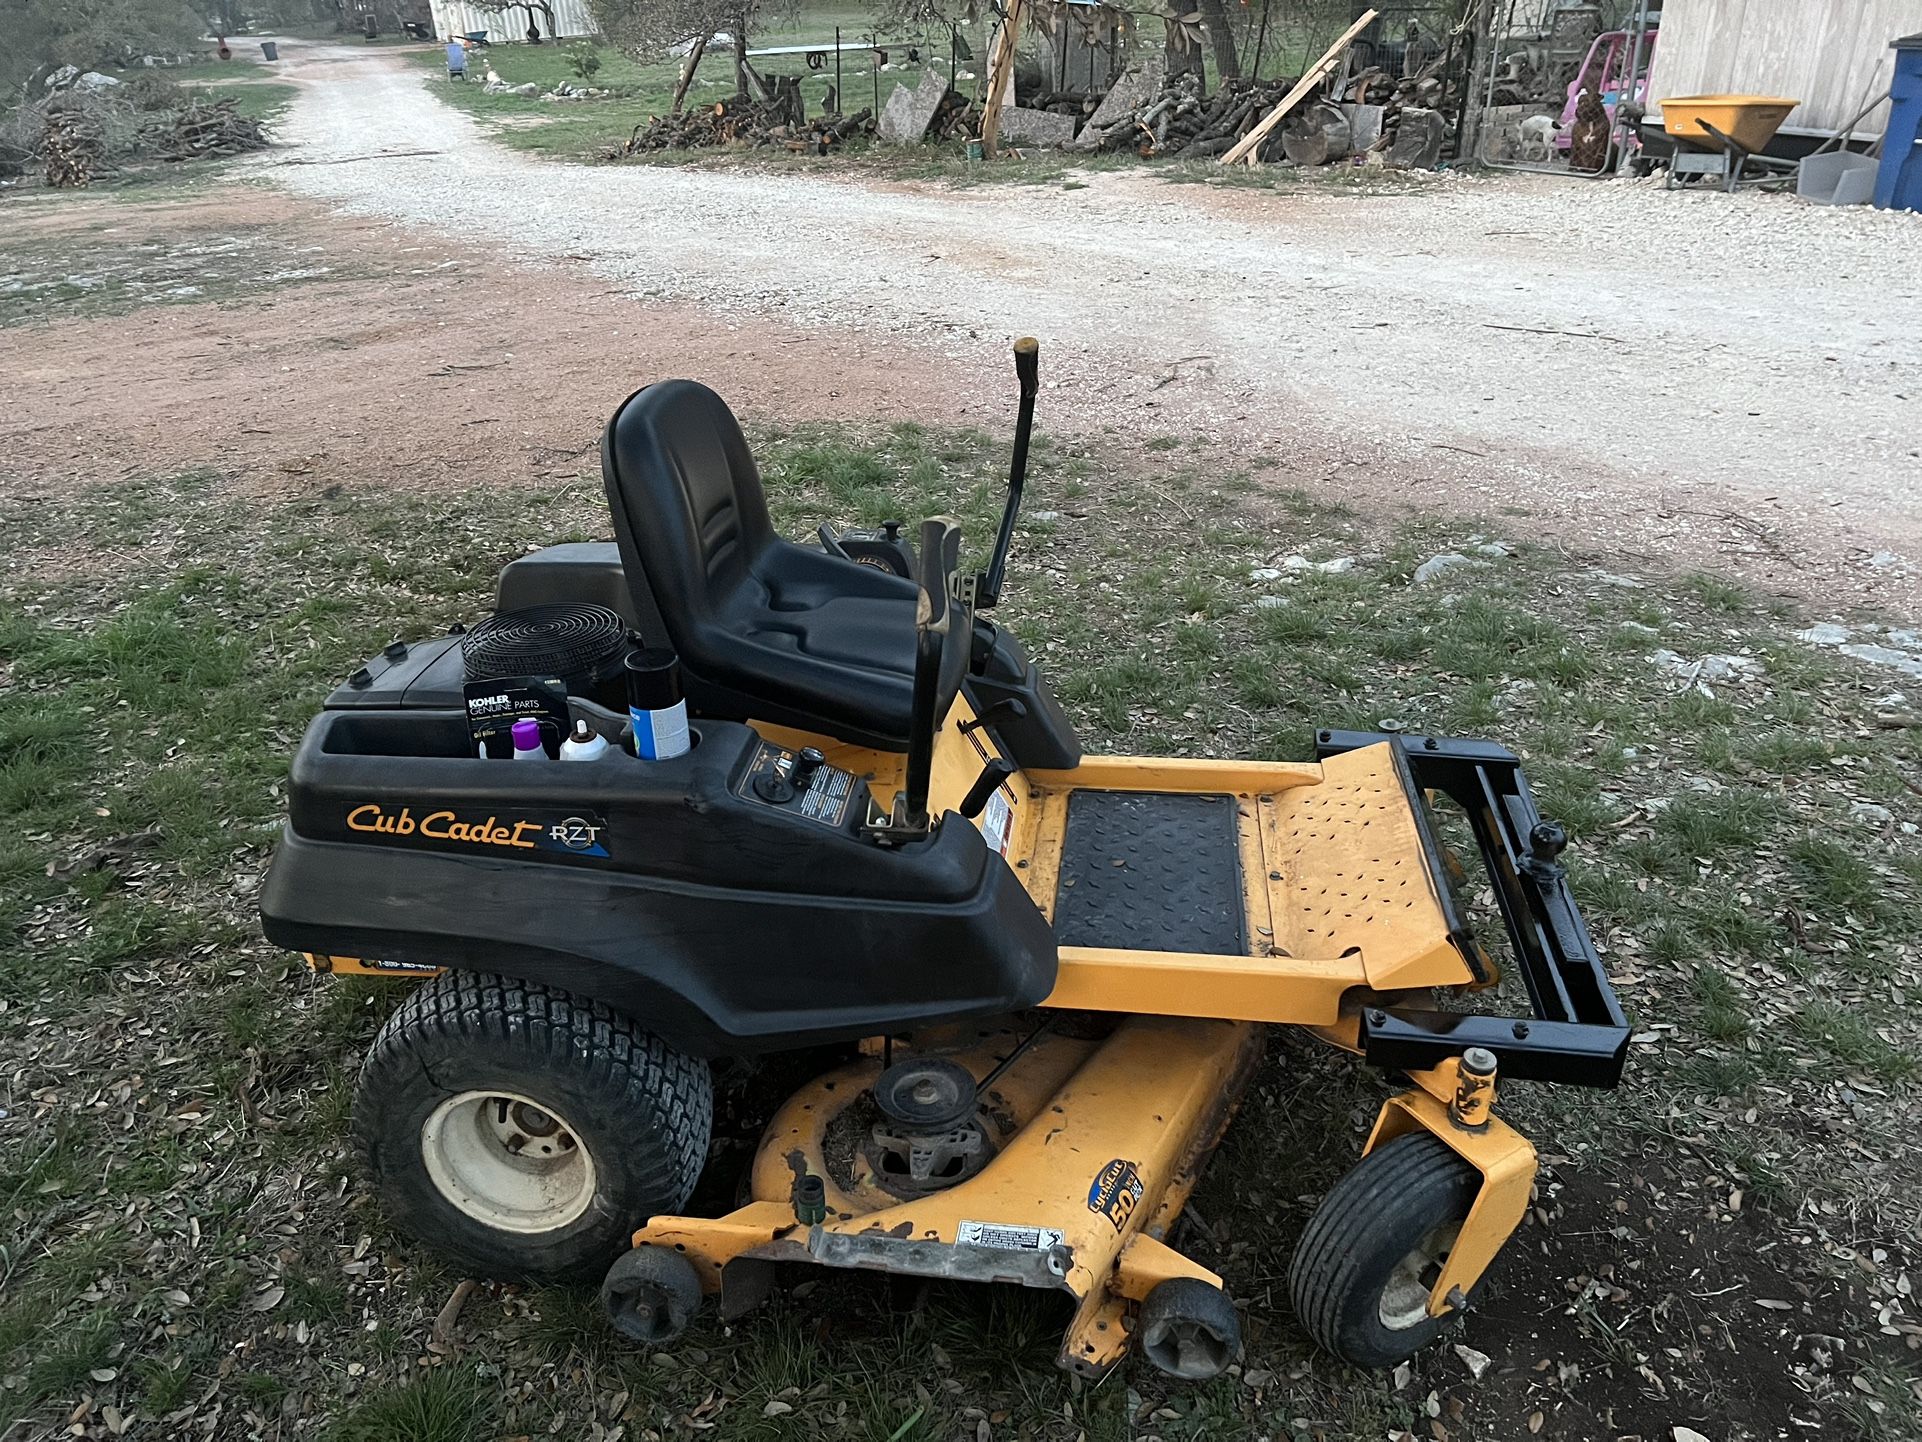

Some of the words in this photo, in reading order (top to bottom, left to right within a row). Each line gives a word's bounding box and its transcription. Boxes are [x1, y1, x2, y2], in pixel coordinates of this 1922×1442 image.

[469, 695, 510, 708] KOHLER
[470, 701, 512, 715] GENUINE
[515, 700, 540, 709] PARTS
[347, 804, 415, 834] Cub
[420, 811, 543, 848] Cadet
[549, 826, 600, 841] RZT
[1110, 1189, 1134, 1230] 50
